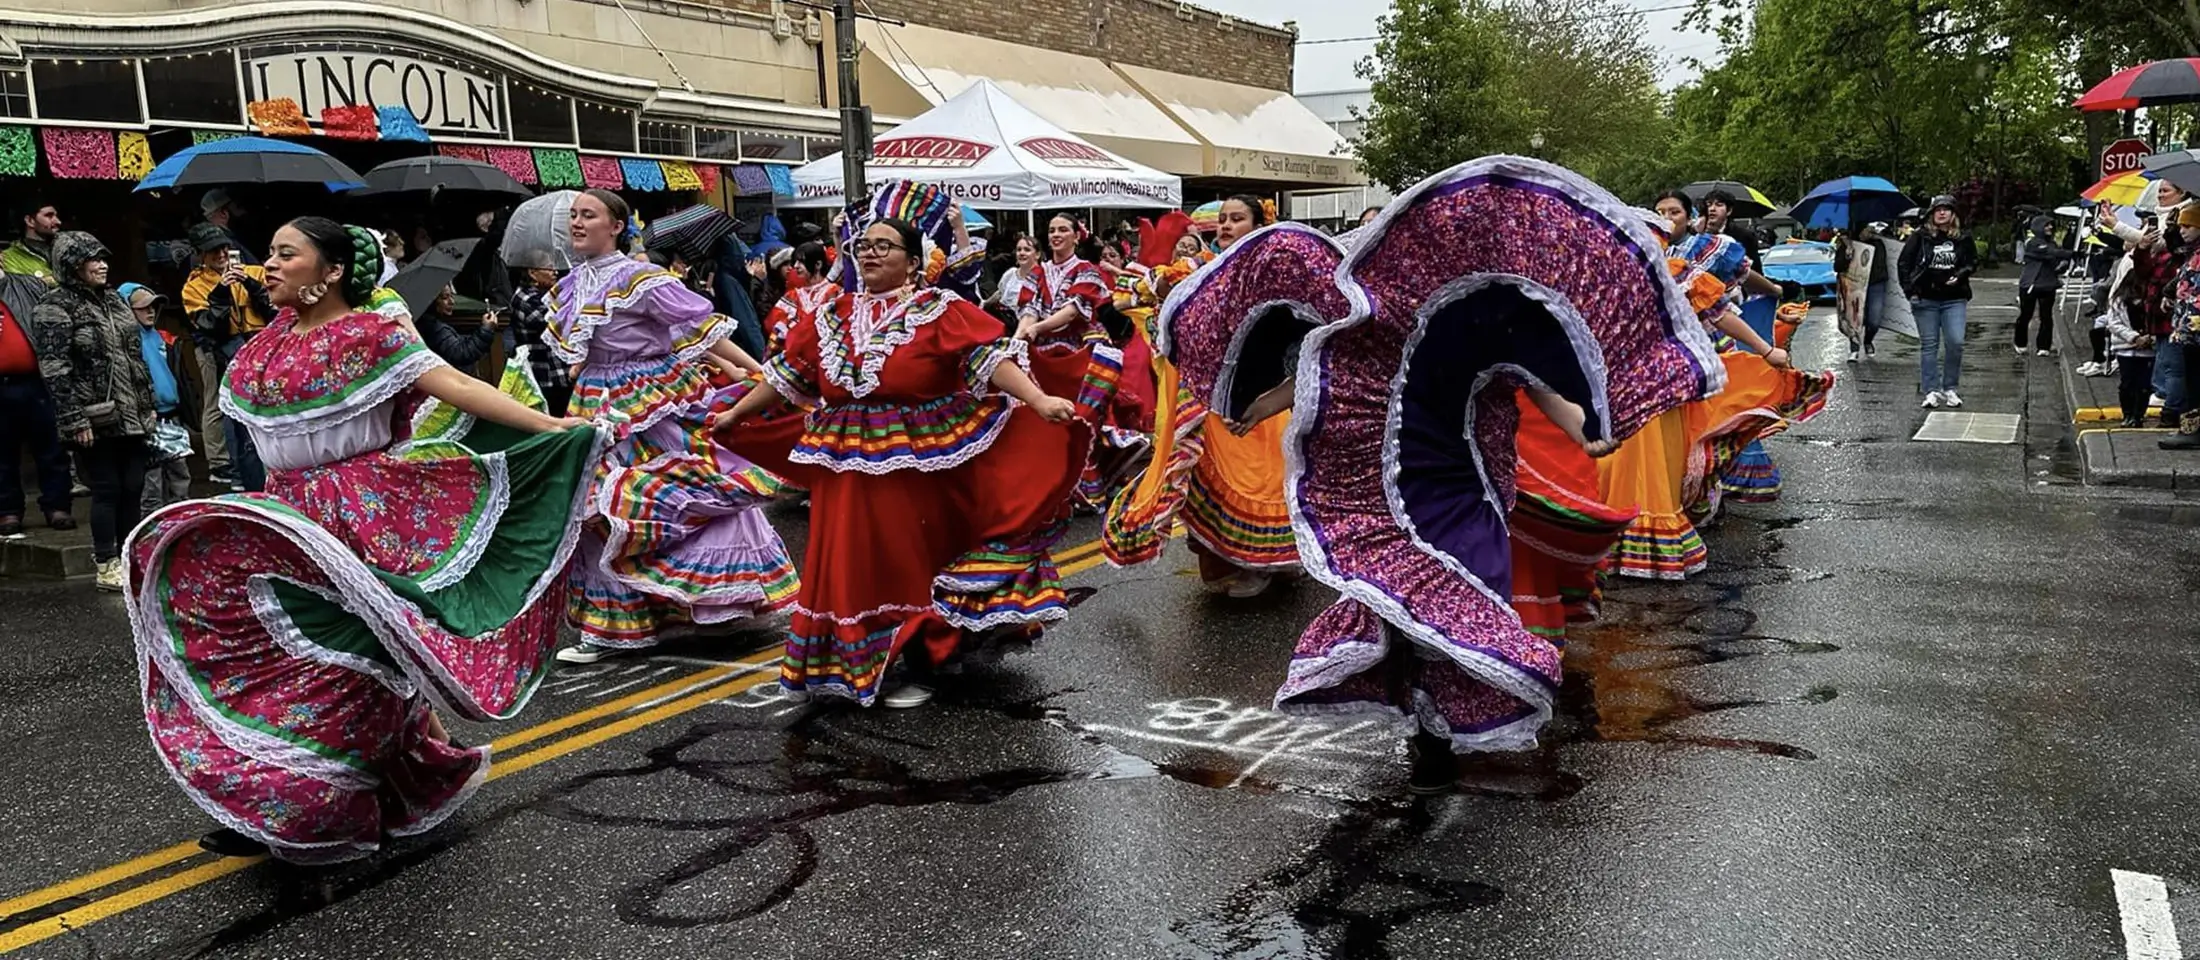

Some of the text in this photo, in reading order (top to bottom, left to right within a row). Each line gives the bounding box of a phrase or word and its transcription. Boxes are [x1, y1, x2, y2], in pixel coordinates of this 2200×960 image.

[874, 158, 969, 166] HEATRE
[1262, 155, 1339, 180] Skagit Running Company
